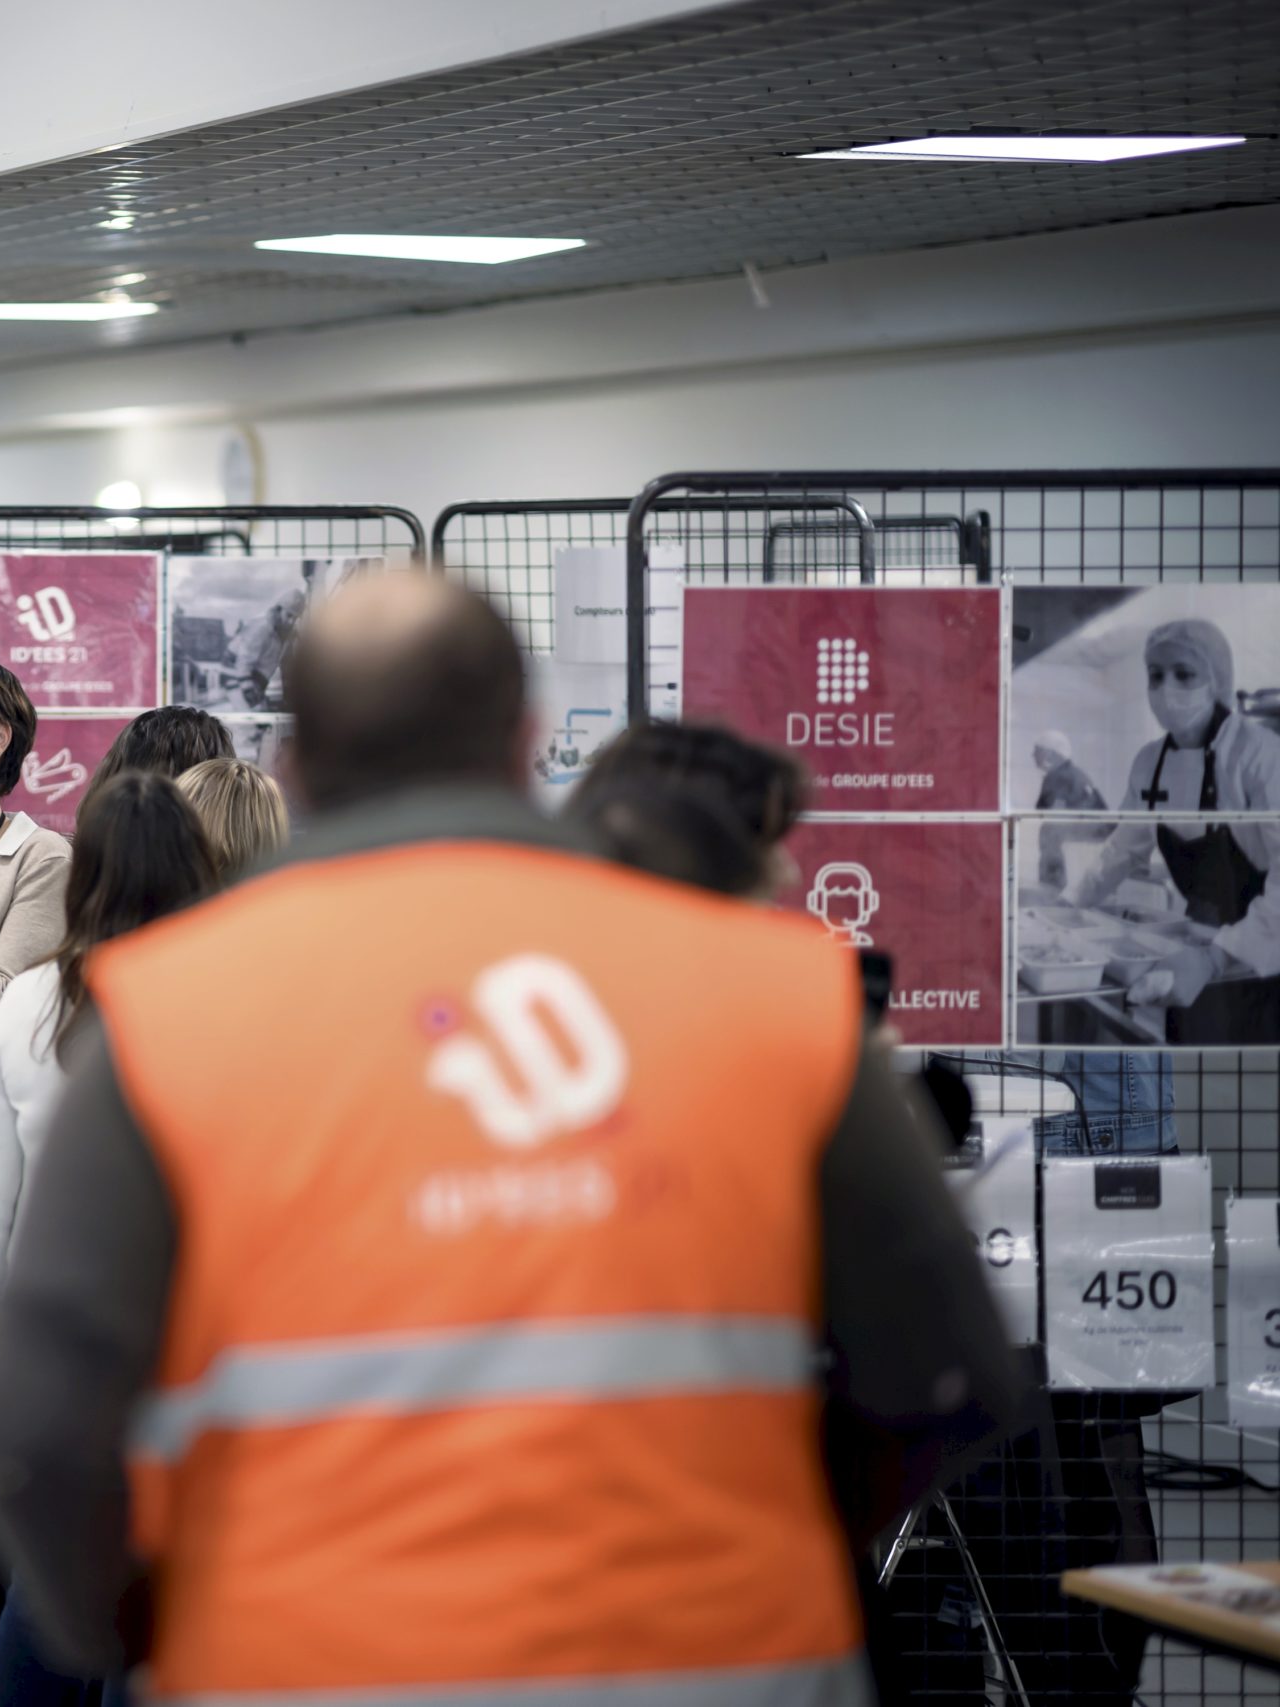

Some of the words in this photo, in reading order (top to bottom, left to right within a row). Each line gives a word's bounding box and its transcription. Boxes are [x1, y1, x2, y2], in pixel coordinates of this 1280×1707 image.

[786, 712, 895, 746] DESIE
[831, 774, 889, 787] GROUPE
[892, 774, 934, 787] ID'EES
[888, 989, 981, 1009] LLECTIVE
[1081, 1270, 1177, 1310] 450
